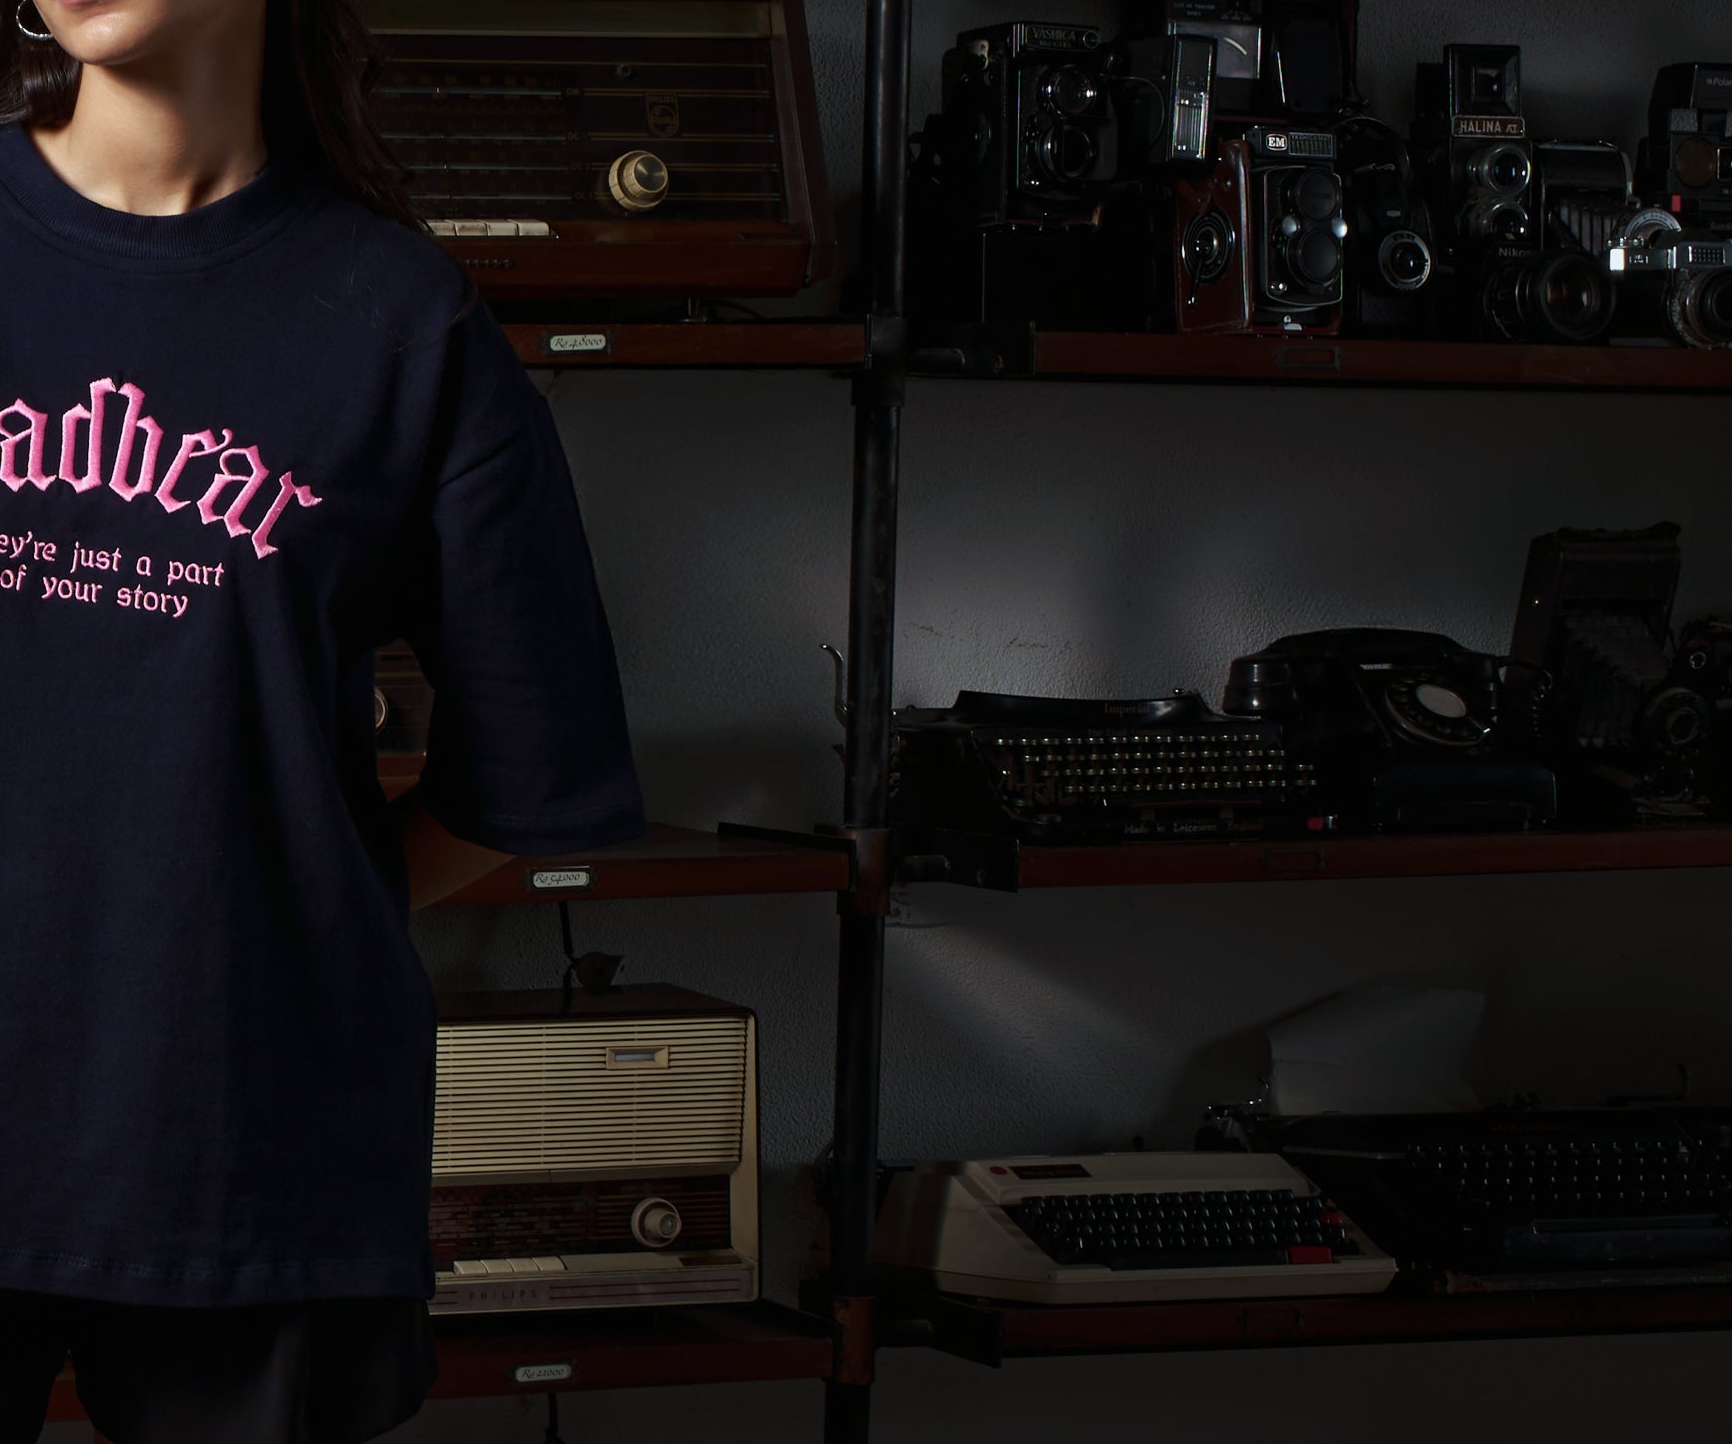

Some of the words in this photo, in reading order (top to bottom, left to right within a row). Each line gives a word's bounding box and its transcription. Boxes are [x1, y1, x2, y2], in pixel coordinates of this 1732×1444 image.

[1031, 27, 1077, 41] YASHICA
[1458, 119, 1502, 134] HALINA
[1268, 136, 1286, 148] EM
[569, 335, 602, 350] 48000
[71, 540, 122, 574] just
[136, 555, 152, 576] a
[167, 560, 225, 589] part
[0, 564, 27, 592] of
[41, 572, 104, 603] your
[116, 583, 190, 619] story
[1103, 702, 1150, 717] Imperial
[1123, 822, 1150, 835] Made
[1172, 820, 1220, 834] Leicester
[469, 1289, 538, 1301] PHILIPS
